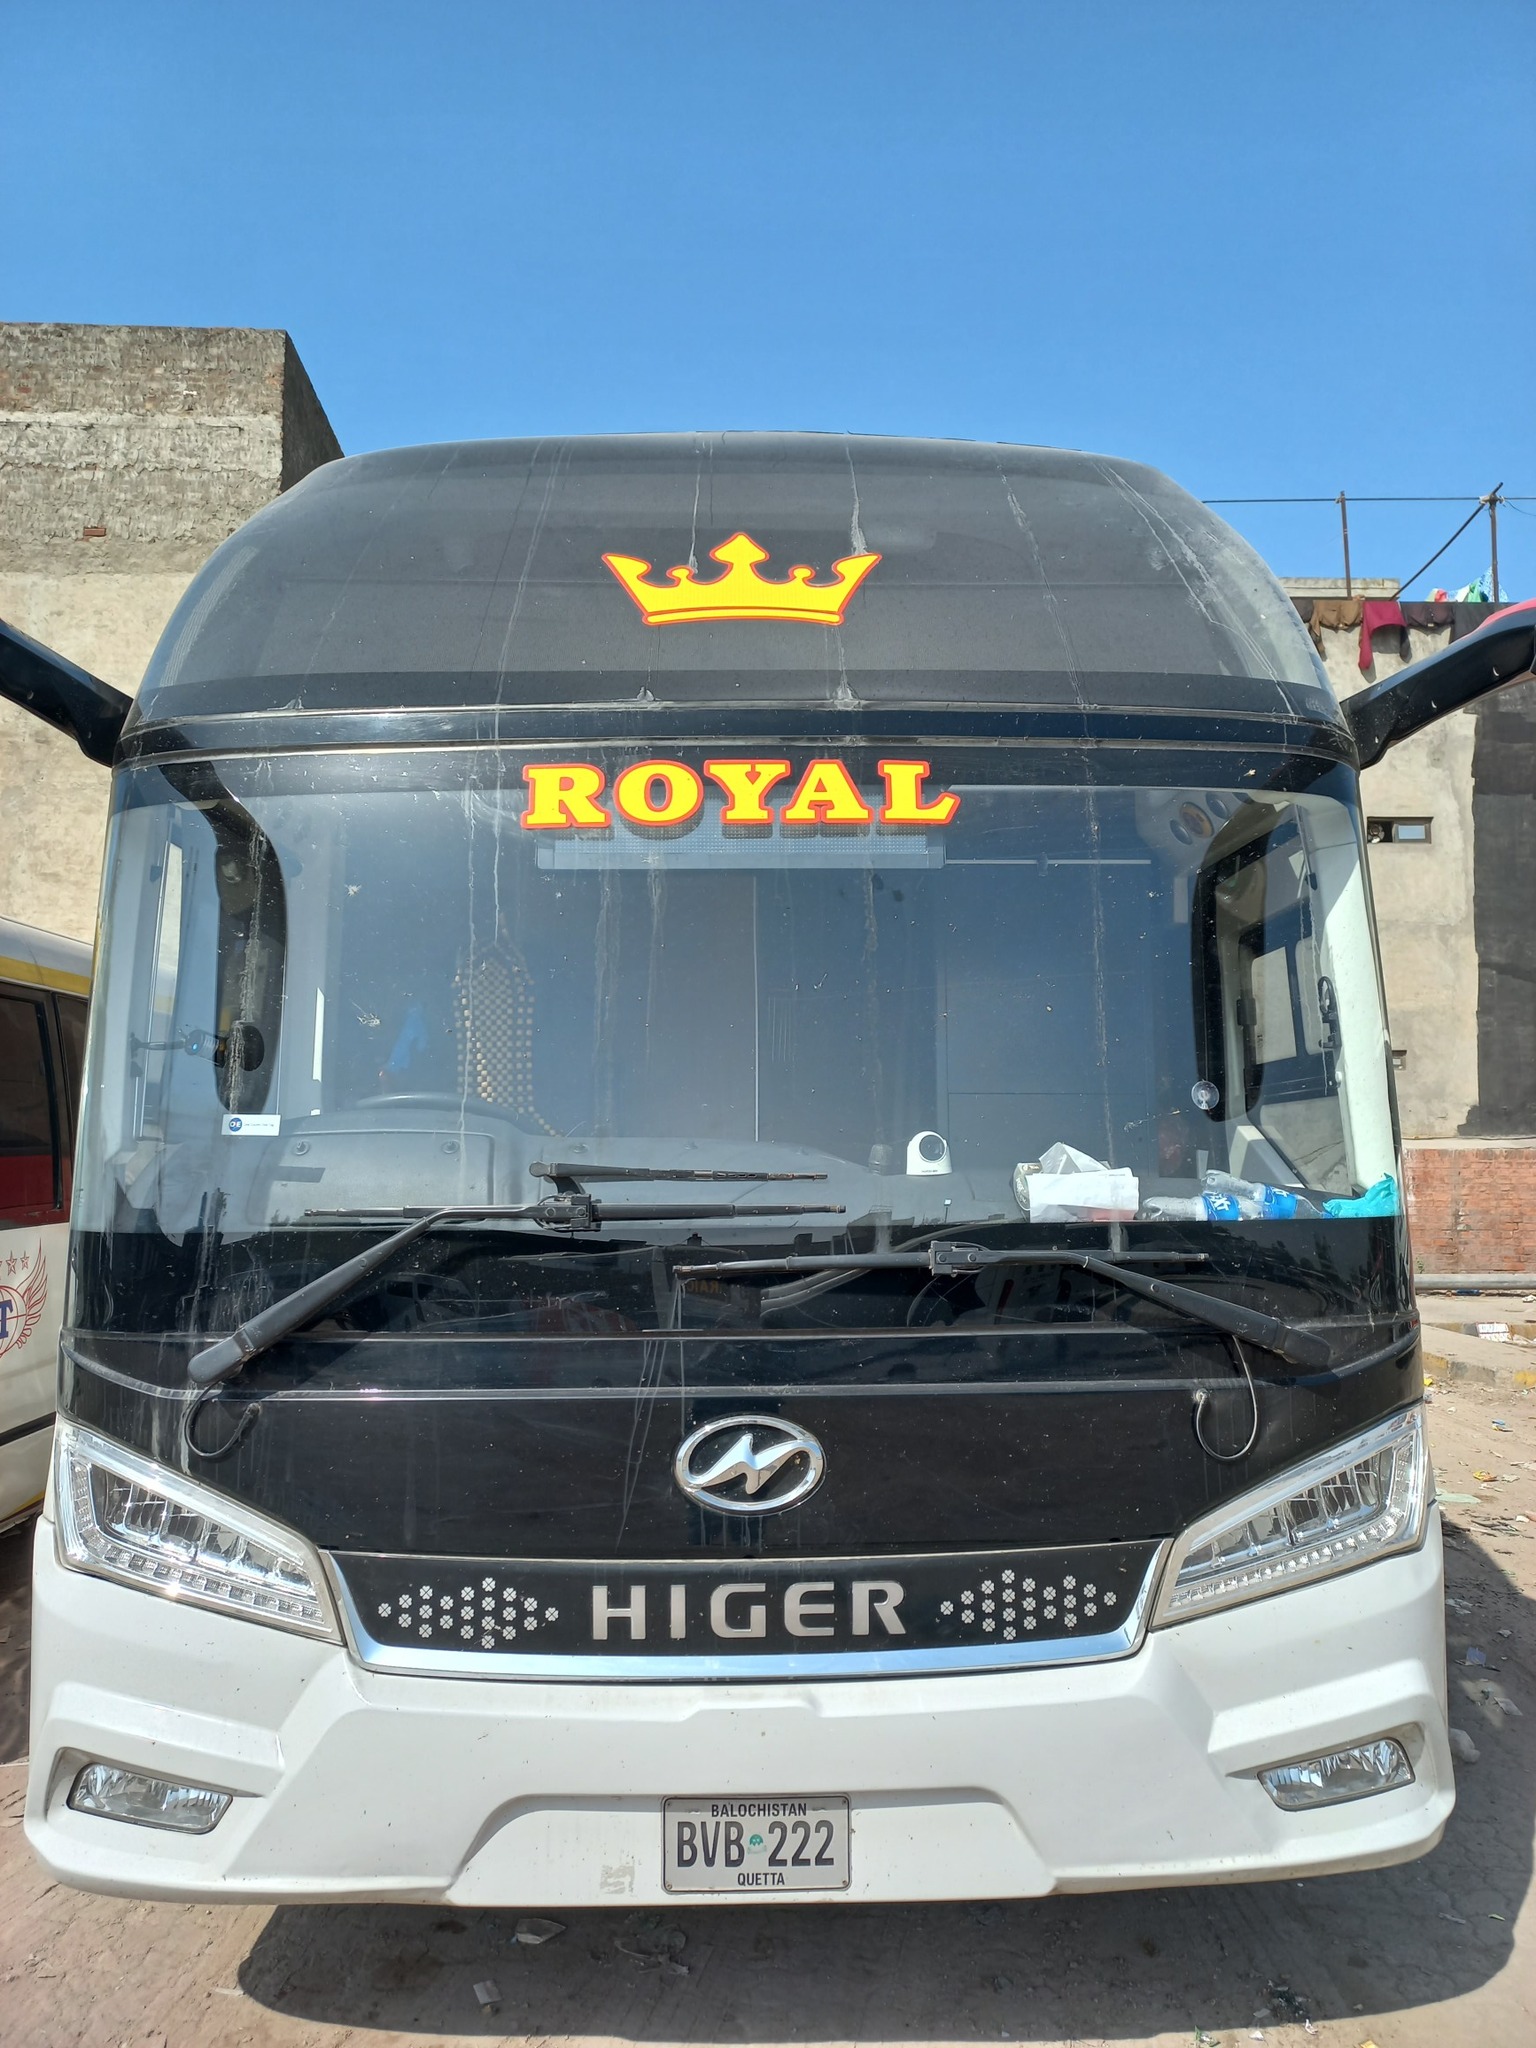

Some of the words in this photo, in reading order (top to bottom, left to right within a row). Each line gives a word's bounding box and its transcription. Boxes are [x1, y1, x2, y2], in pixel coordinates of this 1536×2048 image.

[520, 759, 961, 829] ROYAL
[592, 1580, 906, 1640] HIGER
[711, 1803, 807, 1817] BALOCHISTAN
[677, 1821, 745, 1867] BVB
[768, 1820, 834, 1867] 222
[737, 1872, 785, 1886] QUETTA
